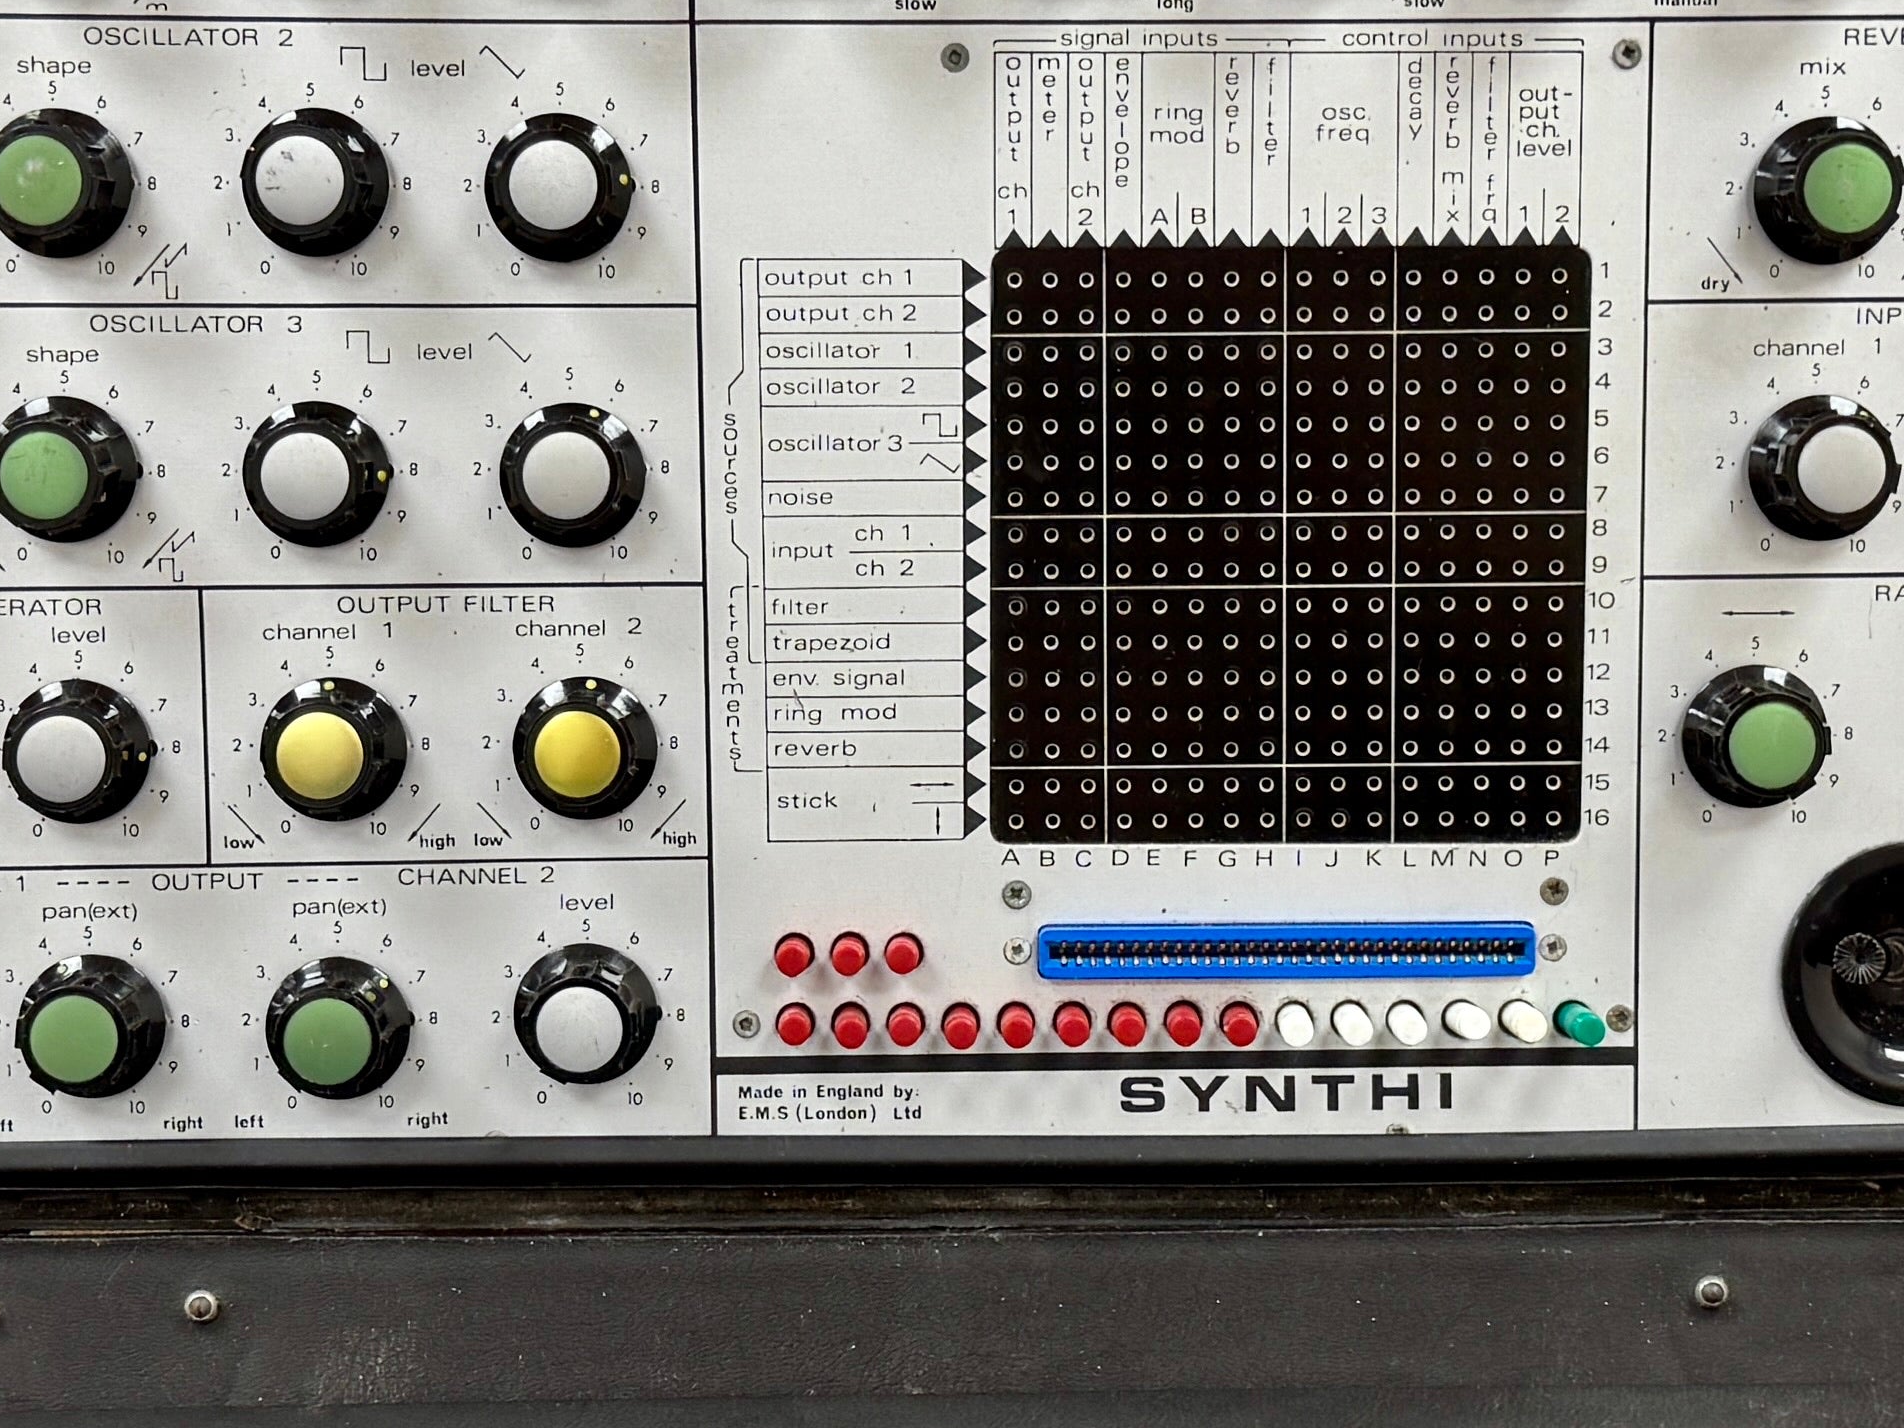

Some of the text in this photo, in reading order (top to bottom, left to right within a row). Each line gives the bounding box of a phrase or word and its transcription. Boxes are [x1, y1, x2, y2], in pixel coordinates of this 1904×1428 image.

[84, 27, 257, 46] OSCILLATOR
[1062, 28, 1217, 49] signal inputs
[1343, 29, 1522, 49] control inputs
[18, 56, 91, 77] shape
[412, 60, 464, 76] level
[1800, 57, 1846, 76] mix
[1155, 108, 1202, 125] ring
[1151, 126, 1203, 144] mod
[1317, 124, 1368, 144] freq
[1518, 139, 1571, 156] level
[765, 271, 846, 288] output
[1702, 277, 1729, 292] dry
[90, 315, 262, 333] OSCILLATOR
[767, 308, 848, 324] output
[27, 346, 99, 365] shape
[418, 344, 471, 360] level
[767, 343, 880, 358] oscillator
[1754, 339, 1844, 356] channel
[767, 379, 880, 395] oscillator
[769, 435, 880, 451] oscillator
[769, 493, 832, 505] noise
[773, 544, 832, 561] input
[338, 596, 553, 613] OUTPUT FILTER
[773, 599, 828, 615] filter
[52, 626, 105, 643] level
[263, 624, 355, 640] channel
[516, 620, 605, 636] channel
[774, 633, 889, 654] trapezoid
[773, 669, 904, 689] env. signal
[775, 704, 896, 725] ring mod
[775, 740, 856, 756] reverb
[778, 792, 837, 808] stick
[224, 836, 254, 848] low
[420, 834, 455, 850] high
[475, 834, 502, 846] low
[664, 832, 696, 848] high
[152, 873, 263, 891] OUTPUT
[399, 868, 526, 885] CHANNEL
[293, 899, 386, 917] pan(ext)
[561, 894, 613, 910] level
[43, 903, 137, 922] pan(ext)
[739, 1084, 919, 1101] Made in England by:
[1120, 1074, 1454, 1112] SYNTHI
[235, 1115, 263, 1127] left
[408, 1112, 447, 1128] right
[739, 1104, 921, 1122] E.M.S (London) Ltd
[164, 1116, 202, 1132] right
